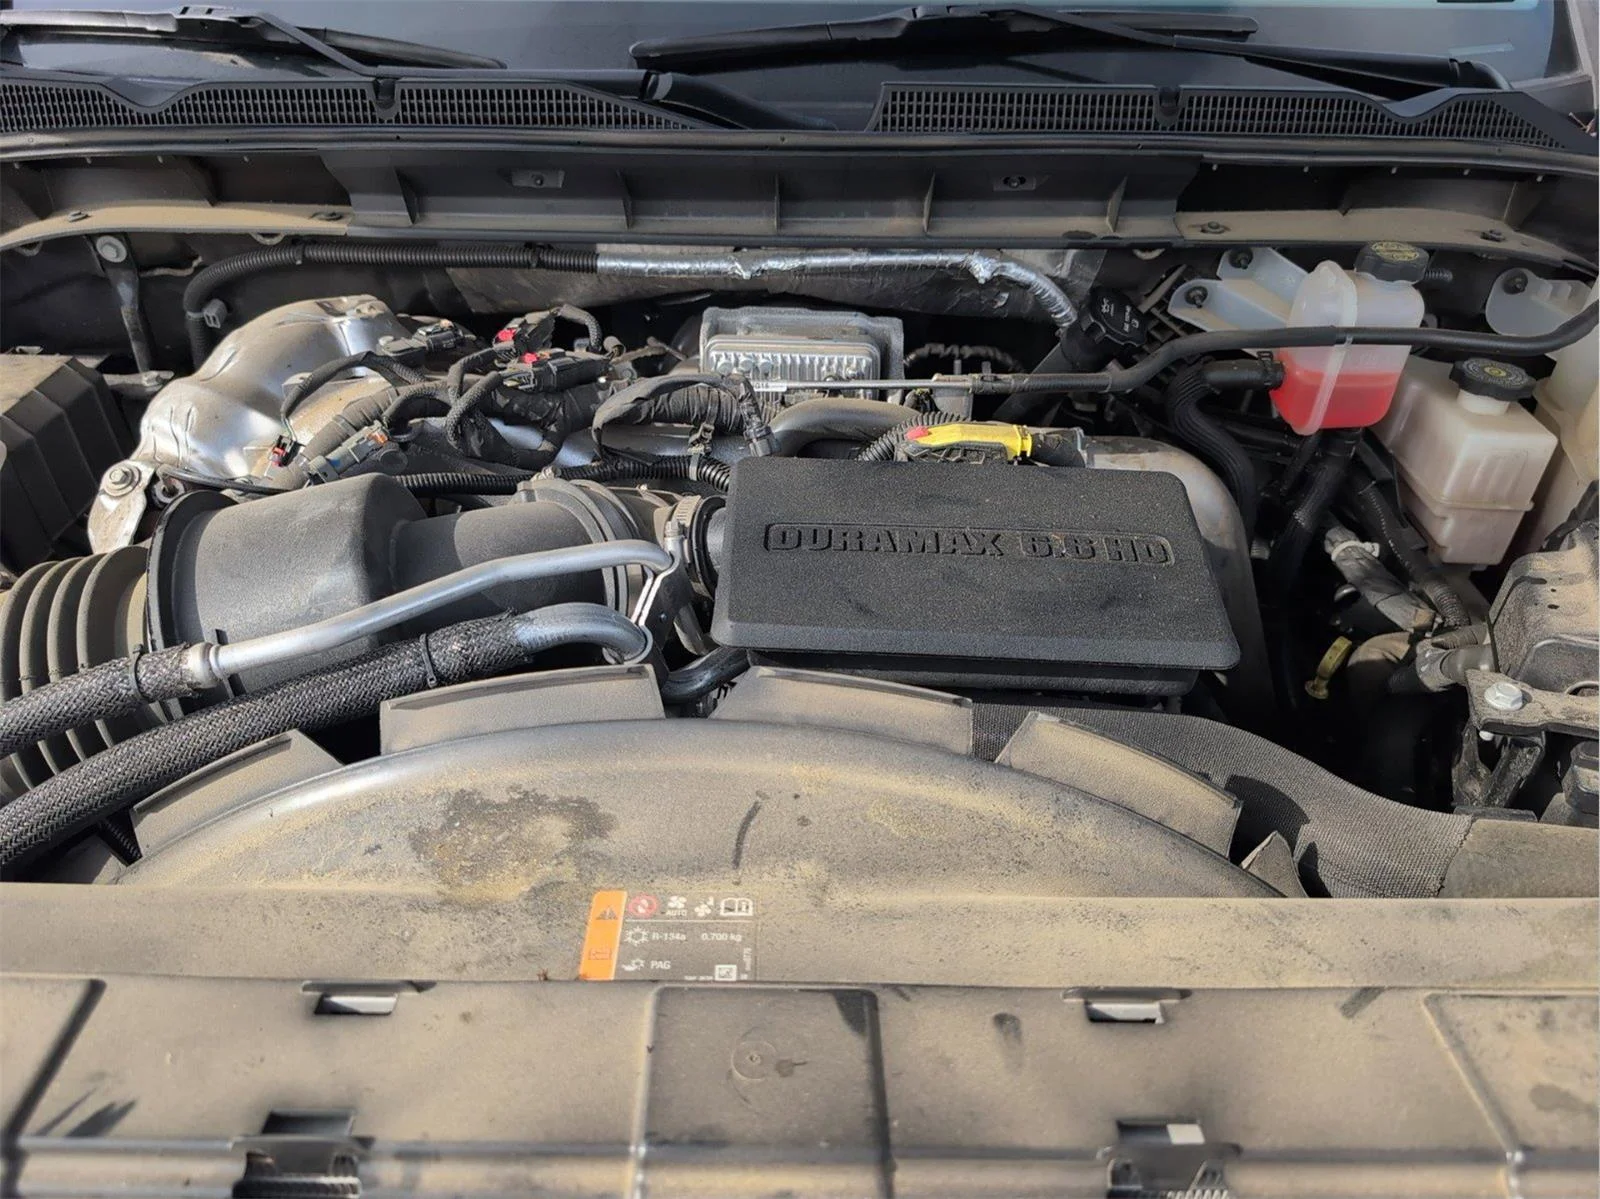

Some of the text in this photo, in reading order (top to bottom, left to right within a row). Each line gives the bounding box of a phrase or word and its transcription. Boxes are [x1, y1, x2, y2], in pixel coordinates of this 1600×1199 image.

[769, 526, 1174, 565] DURAMAX 6.6 HD
[665, 909, 688, 917] AUTO
[651, 931, 743, 943] R-134a 0.700 kg
[650, 960, 672, 970] PAG
